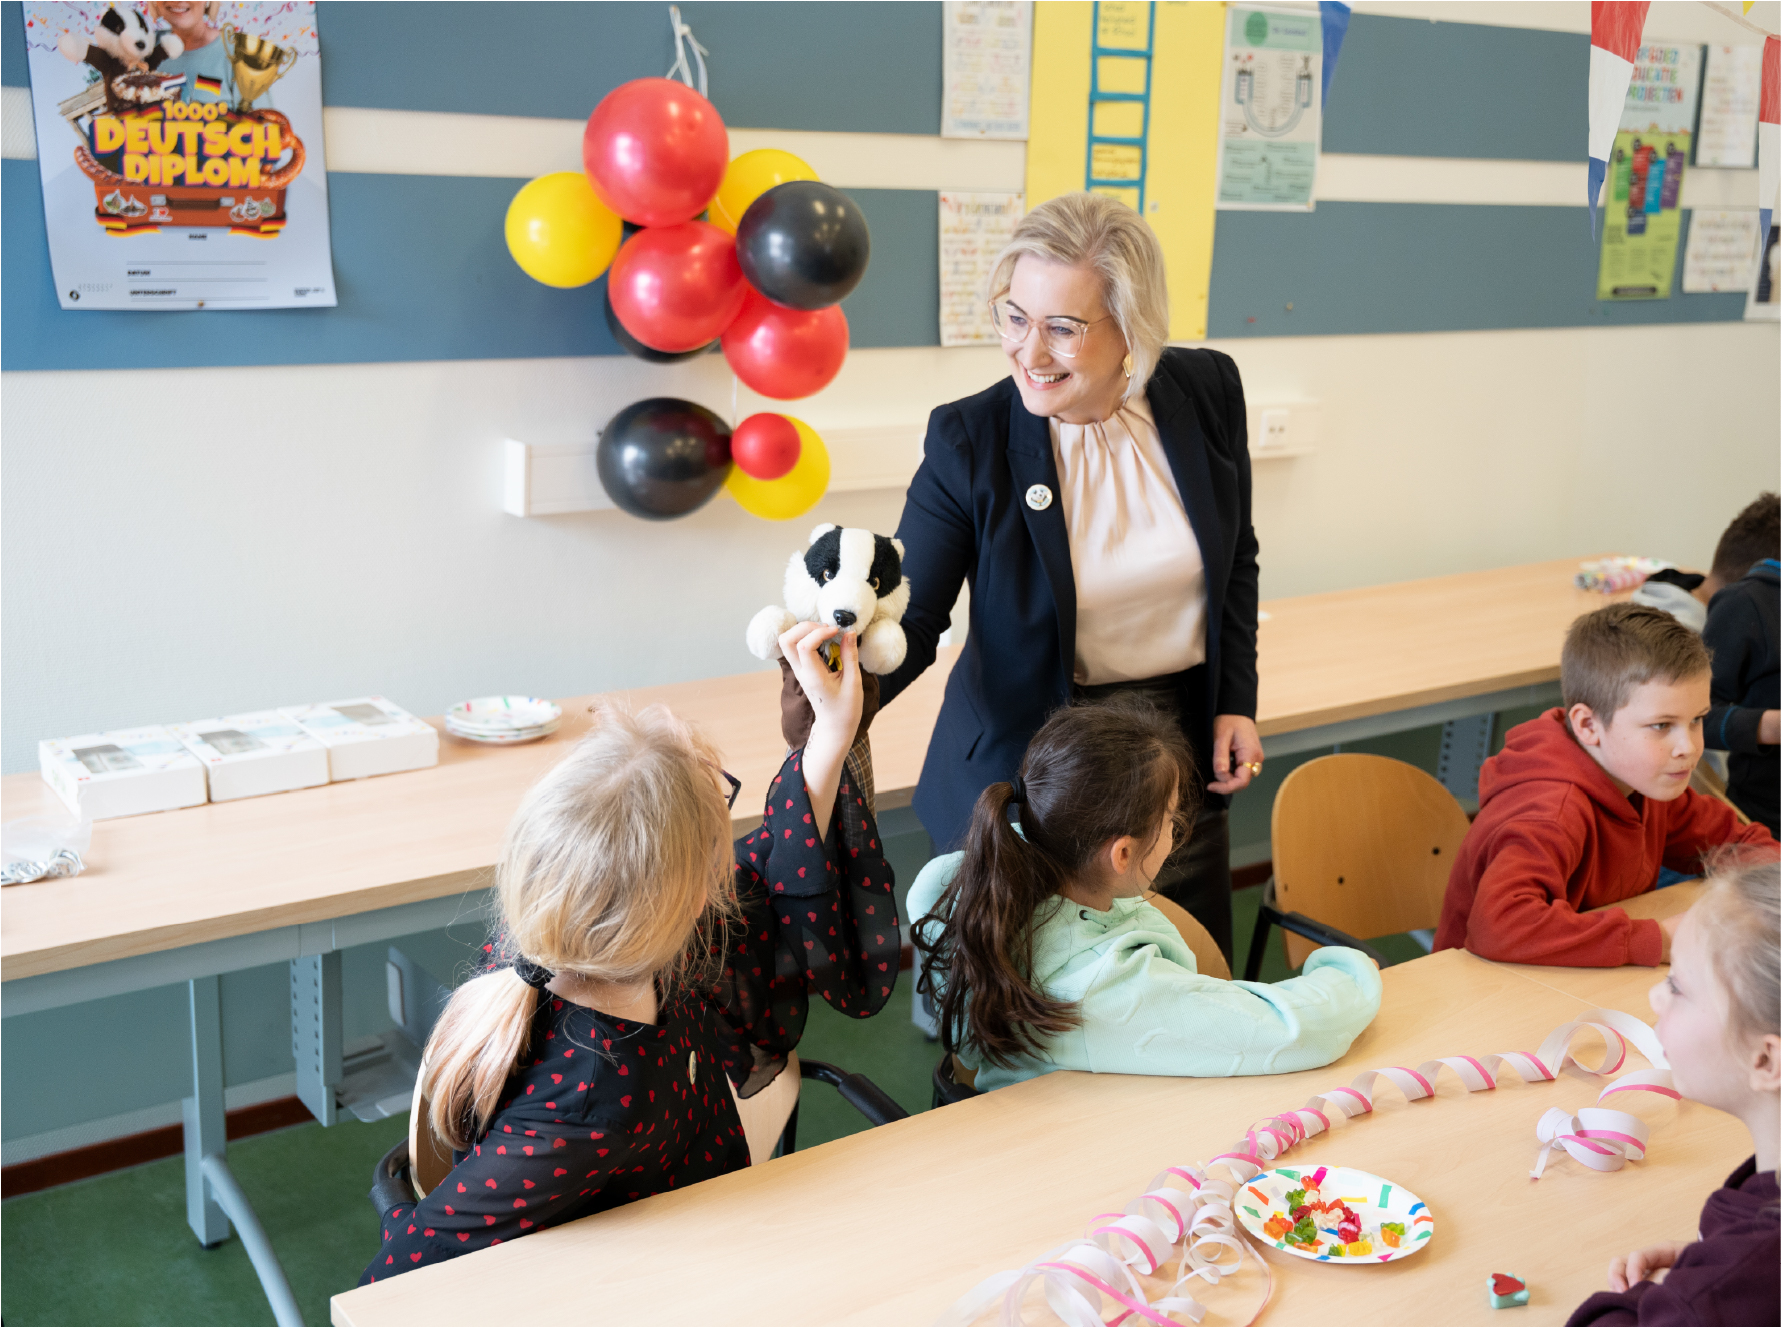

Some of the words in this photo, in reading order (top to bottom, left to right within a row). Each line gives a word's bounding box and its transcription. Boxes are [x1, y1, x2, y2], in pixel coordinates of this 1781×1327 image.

[1631, 66, 1677, 84] DUCATIE
[94, 118, 282, 160] DEUTSCH
[122, 153, 261, 189] DIPLOM
